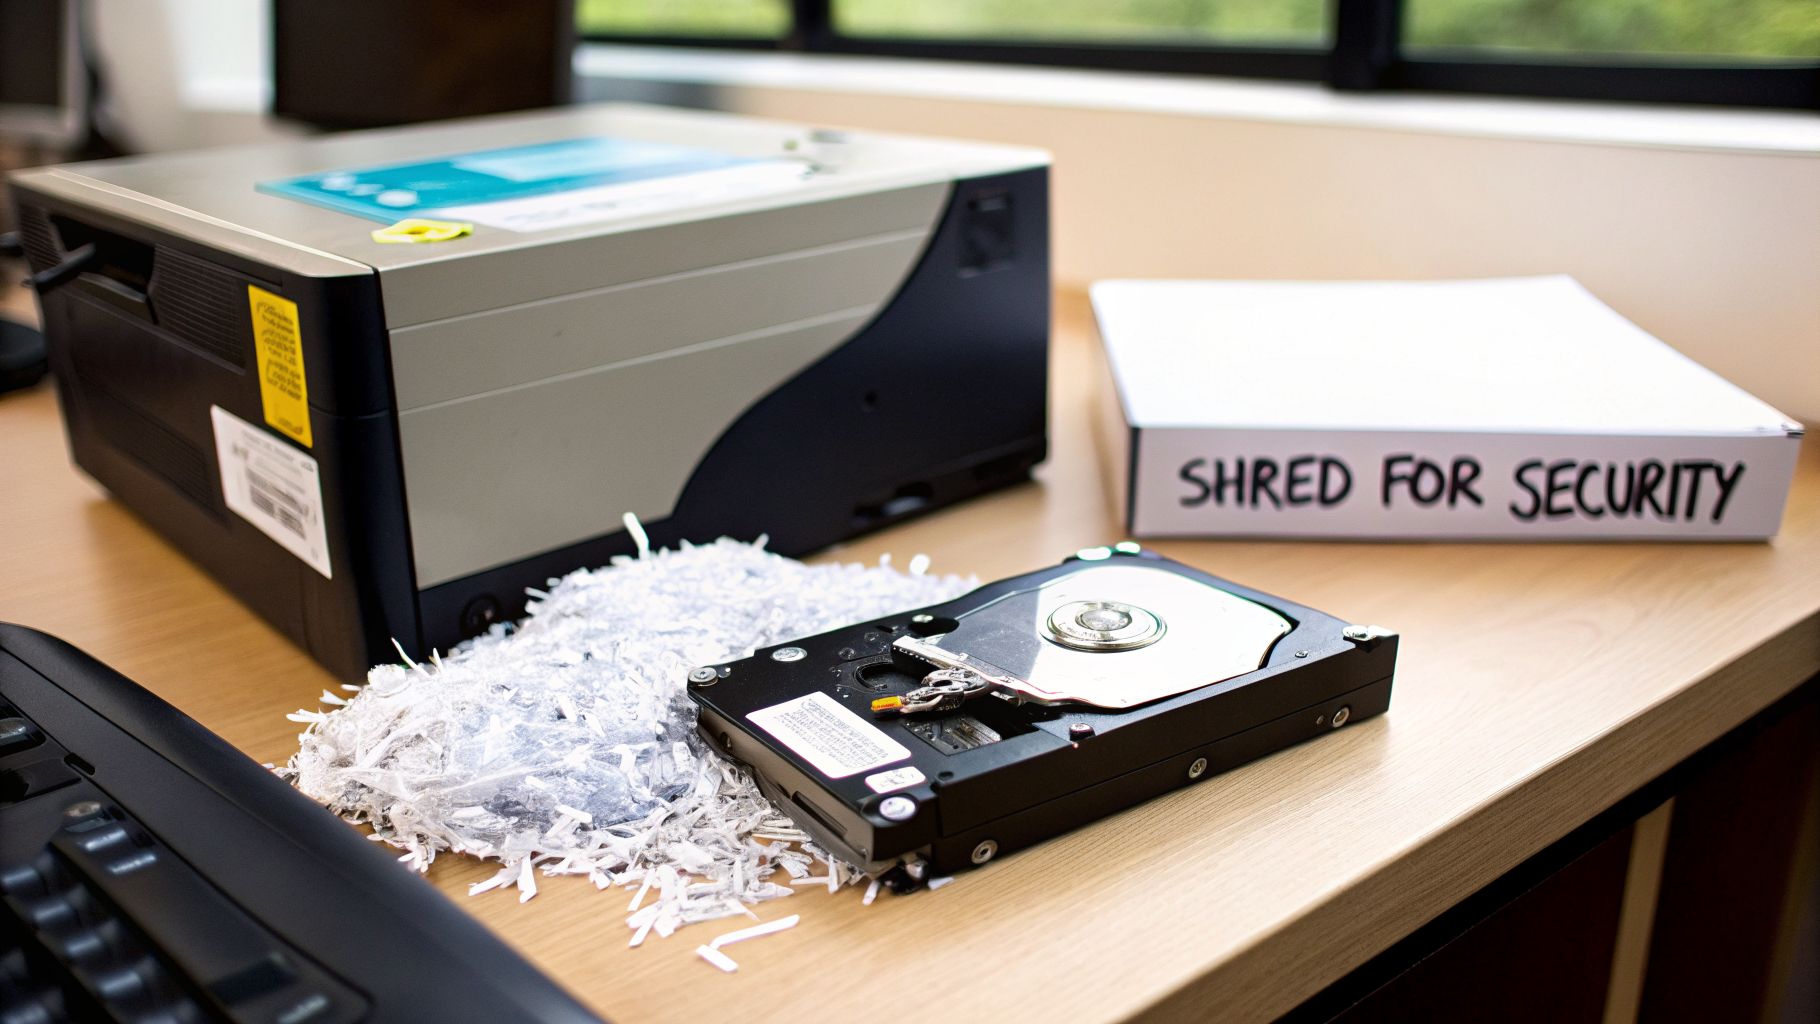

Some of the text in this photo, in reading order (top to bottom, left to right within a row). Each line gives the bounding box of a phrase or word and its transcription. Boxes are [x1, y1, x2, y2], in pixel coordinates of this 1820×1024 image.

[1179, 455, 1746, 525] SHRED FOR SECURITY
